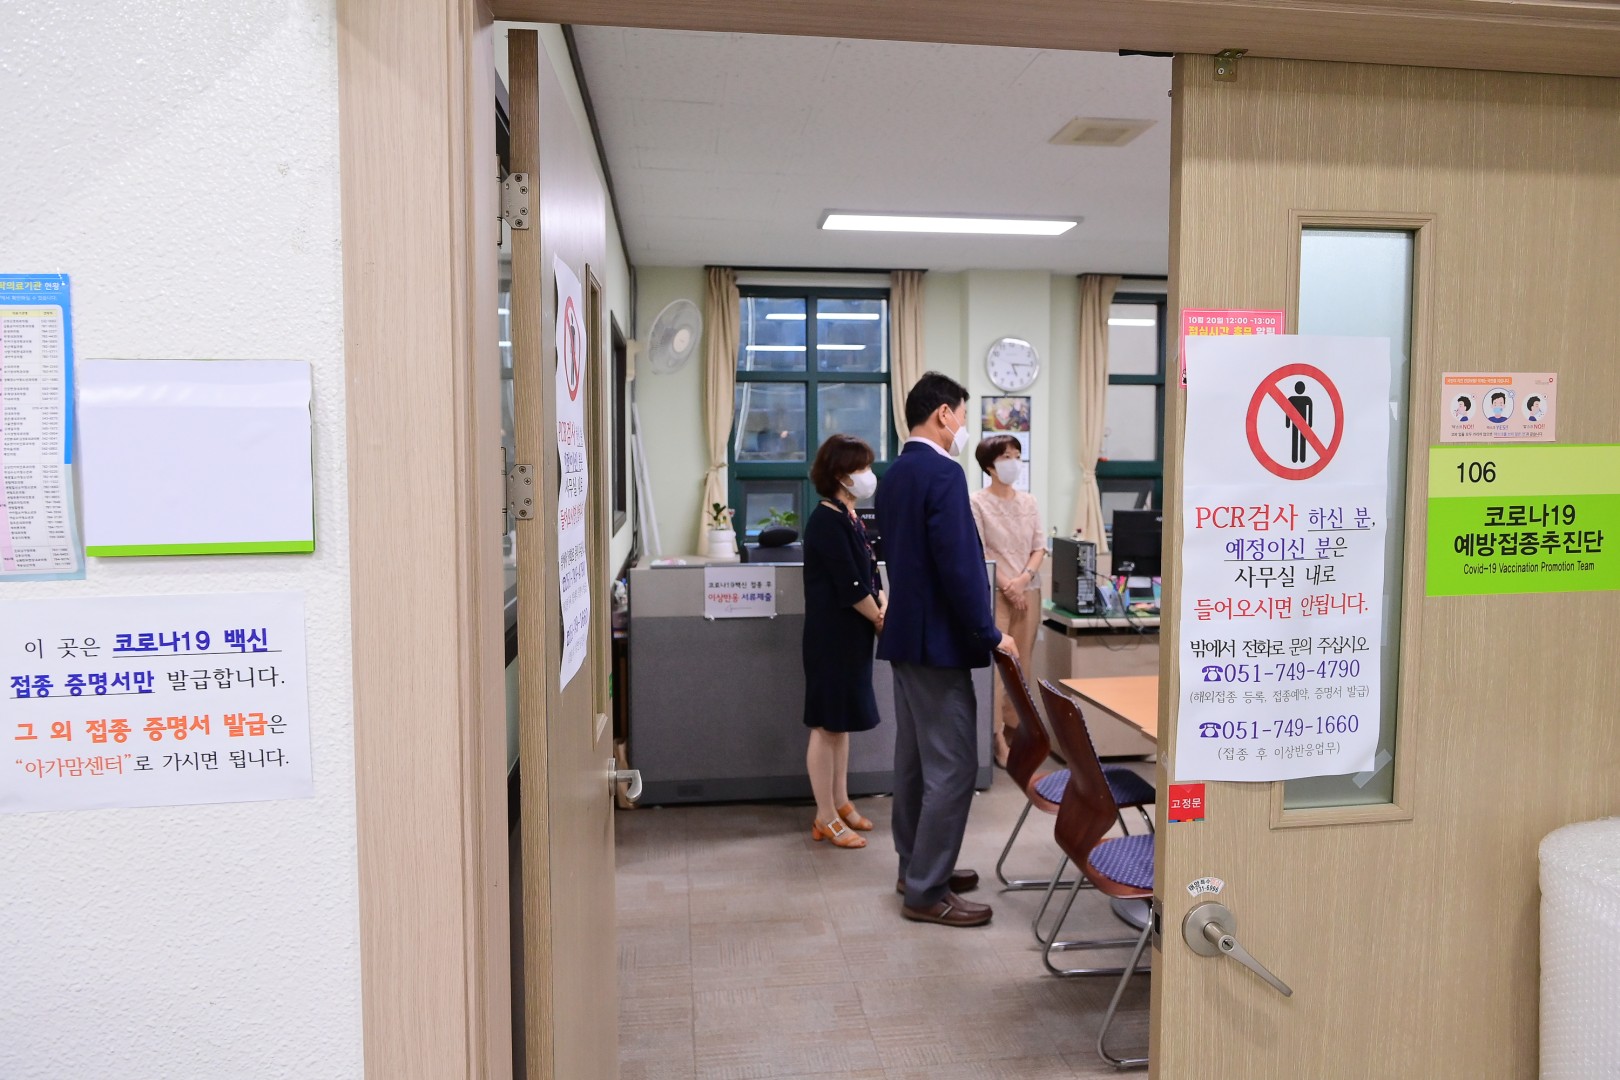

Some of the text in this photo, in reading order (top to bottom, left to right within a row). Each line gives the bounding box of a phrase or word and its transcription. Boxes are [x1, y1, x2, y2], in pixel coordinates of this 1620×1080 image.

[45, 282, 60, 291] 현황
[1457, 462, 1496, 483] 106
[1196, 504, 1375, 531] PCR검사 하신 분,
[1484, 504, 1576, 527] 코로나19
[1226, 537, 1347, 560] 예정이신 분은
[1454, 530, 1604, 556] 예방접종추진단
[1235, 565, 1336, 588] 사무실 내로
[1464, 561, 1594, 574] Covid-19 Vaccination Promotion Team
[708, 593, 772, 603] 이상반응 서류제출
[1194, 592, 1369, 620] 들어오시면 안됩니다.
[24, 628, 268, 659] 이 곳은 코로나19 백신
[1190, 636, 1369, 658] 밖에서 전화로 문의 주십시오
[10, 666, 285, 698] 접종 증명서만 발급합니다.
[1224, 660, 1360, 683] 051-749-4790
[1190, 691, 1237, 704] (해외접종
[1314, 686, 1342, 700] 증명서
[1347, 685, 1369, 698] 발급)
[14, 712, 287, 743] 그 외 접종 증명서 발급은
[1222, 715, 1359, 739] 051-749-1660
[162, 751, 218, 772] 가시면
[228, 748, 289, 768] 됩니다.
[1218, 741, 1340, 761] (접종 후 이상반응업무)
[1171, 798, 1201, 809] 고정문
